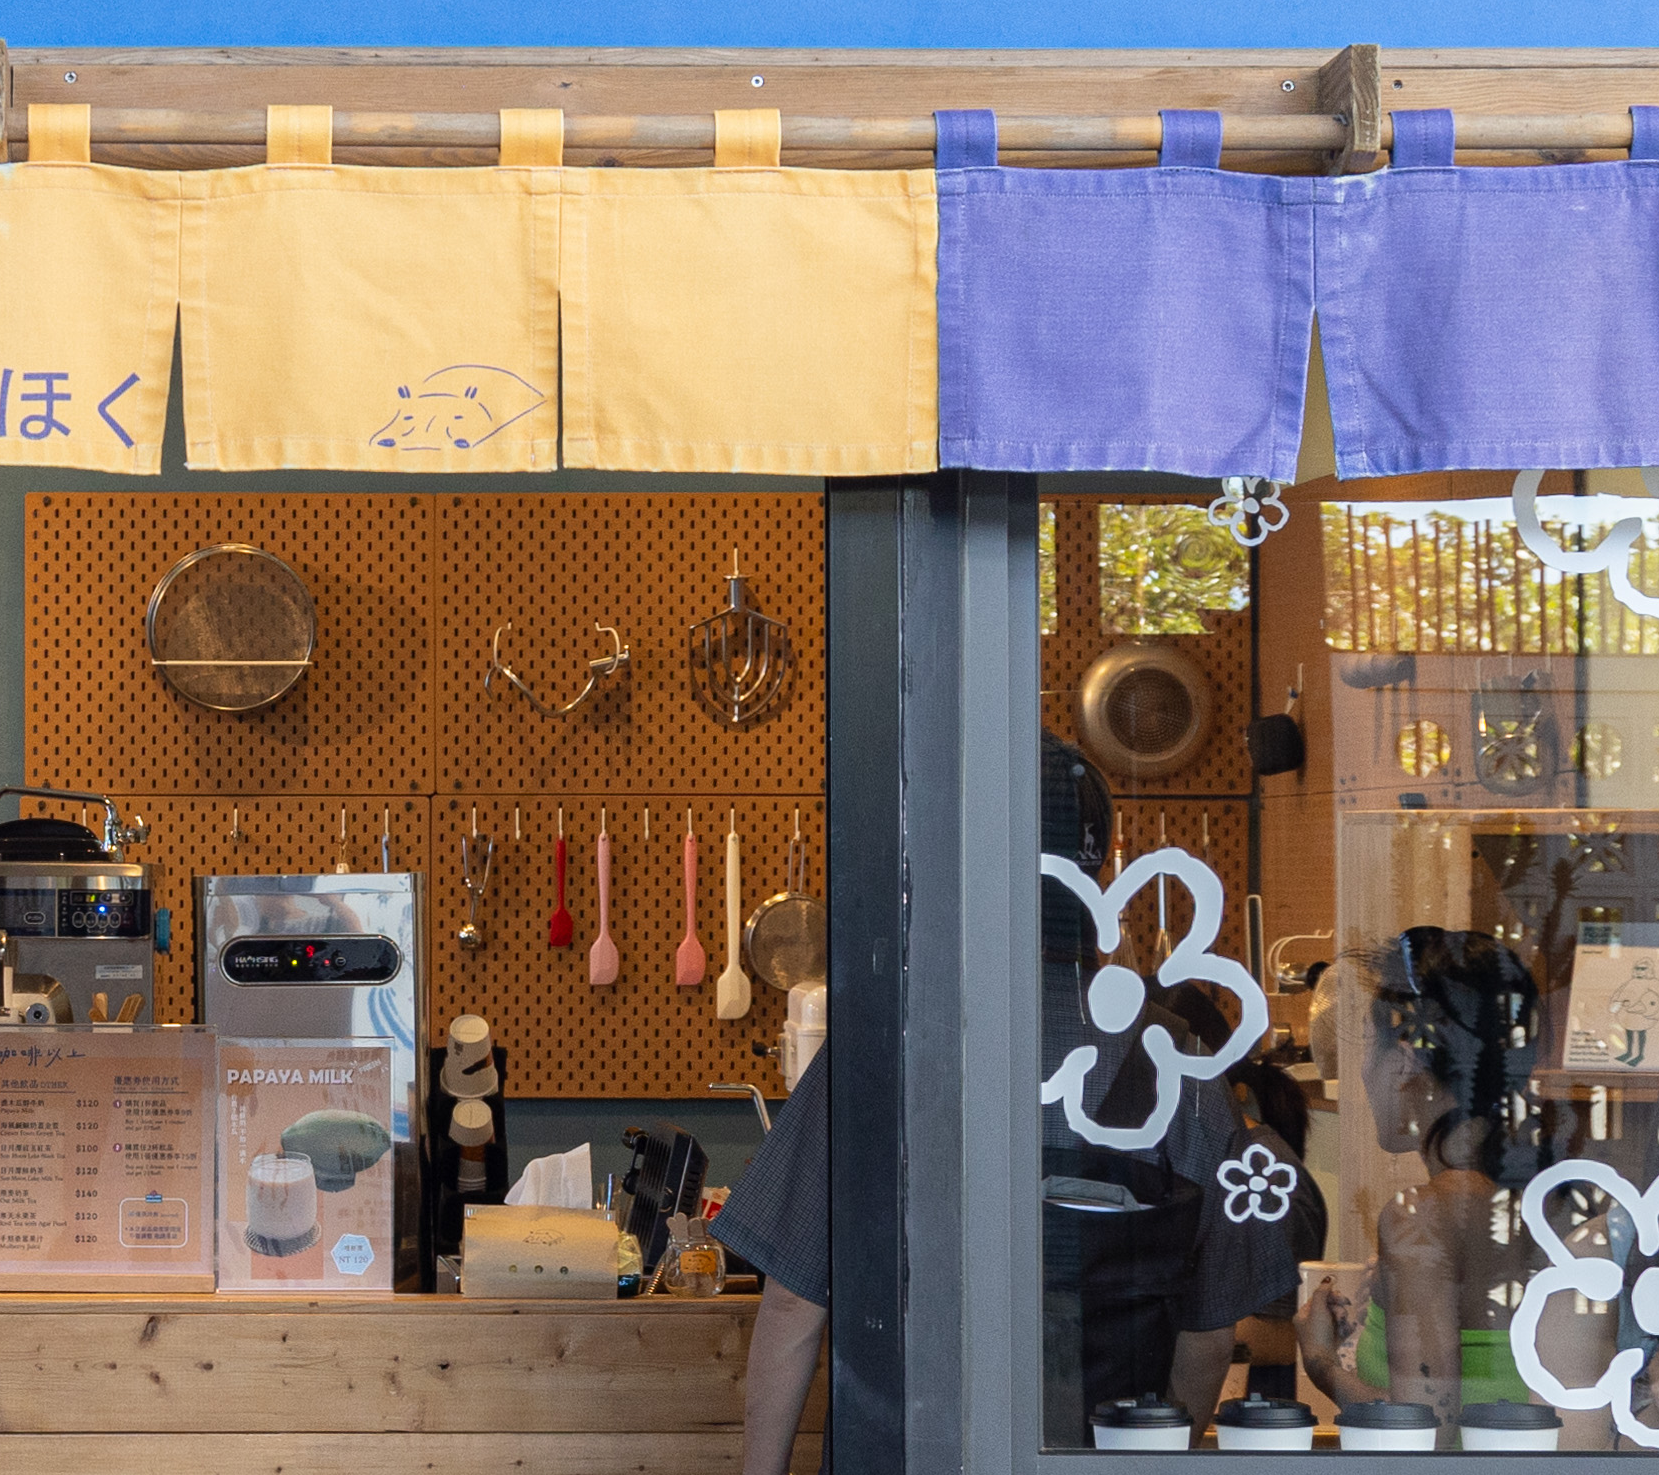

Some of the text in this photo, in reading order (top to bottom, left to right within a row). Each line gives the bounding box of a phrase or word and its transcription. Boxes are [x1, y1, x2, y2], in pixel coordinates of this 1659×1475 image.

[226, 1068, 354, 1085] PAPAYA MILK
[76, 1099, 99, 1108] $120
[76, 1122, 99, 1130] $120
[76, 1144, 99, 1153] $100
[75, 1166, 99, 1175] $120
[75, 1189, 98, 1198] $140
[75, 1212, 98, 1220] $120
[75, 1234, 98, 1243] $120
[338, 1256, 351, 1264] NT
